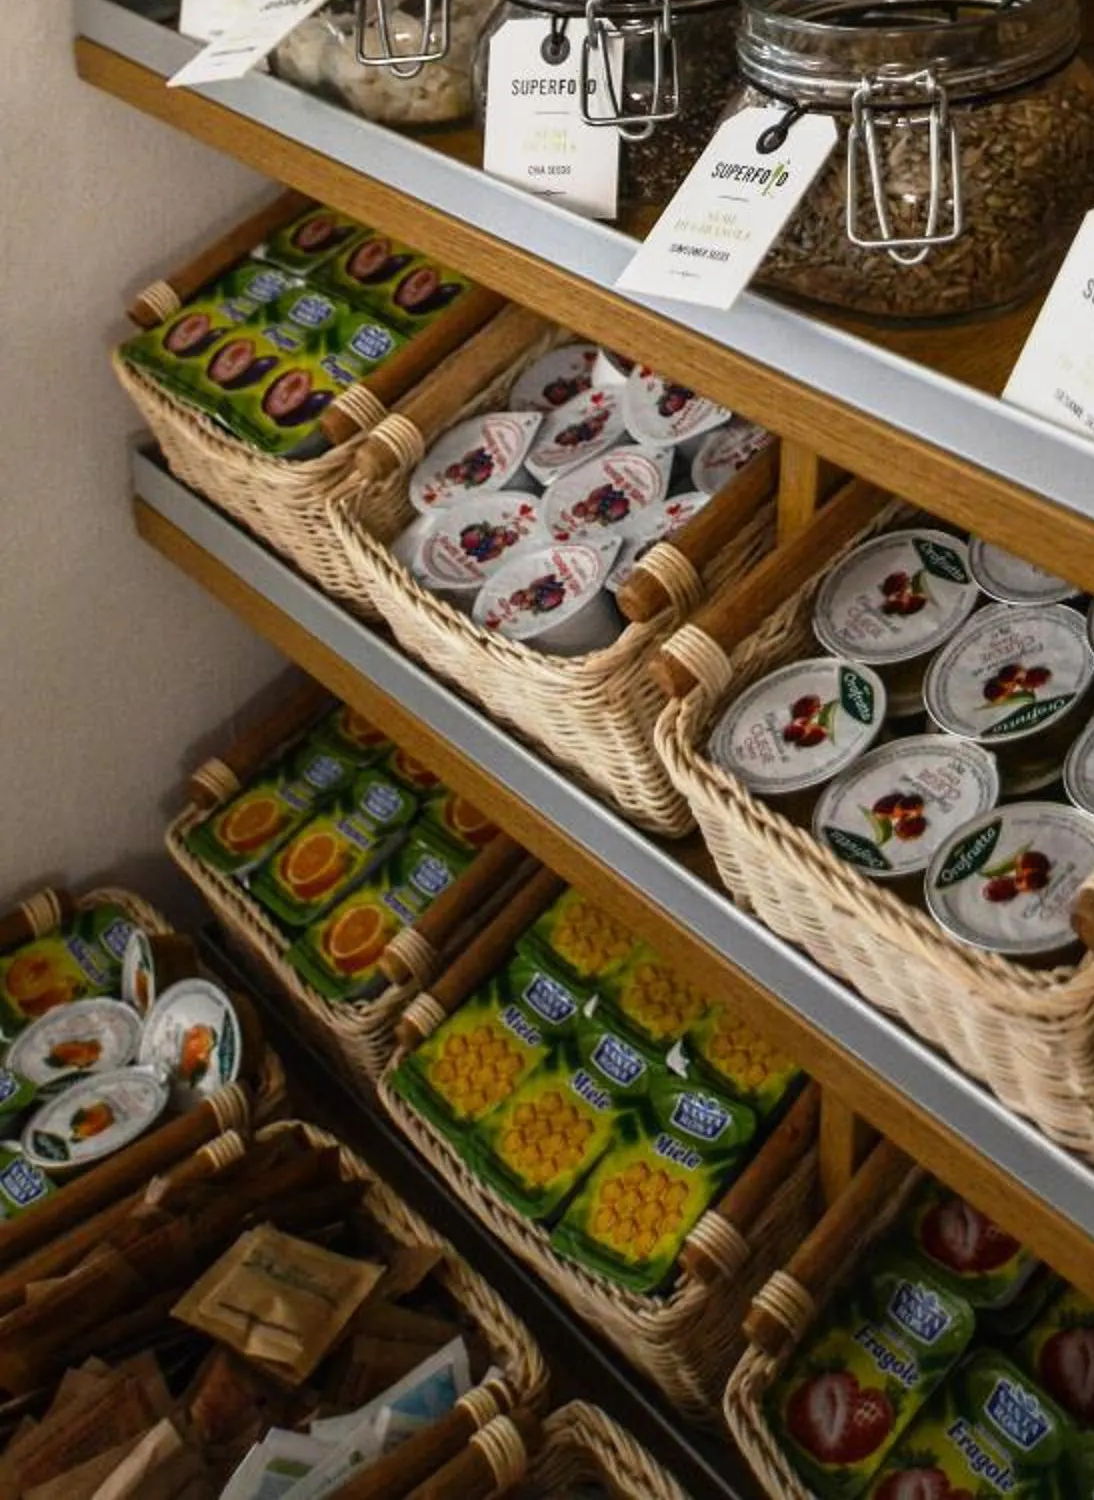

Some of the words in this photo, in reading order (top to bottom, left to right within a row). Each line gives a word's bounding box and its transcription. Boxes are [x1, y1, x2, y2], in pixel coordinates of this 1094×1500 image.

[503, 1005, 541, 1046] Miele
[572, 1070, 611, 1110] Miele
[655, 1135, 702, 1169] Miele
[854, 1325, 921, 1388] Fragole
[948, 1419, 1014, 1492] Fragole
